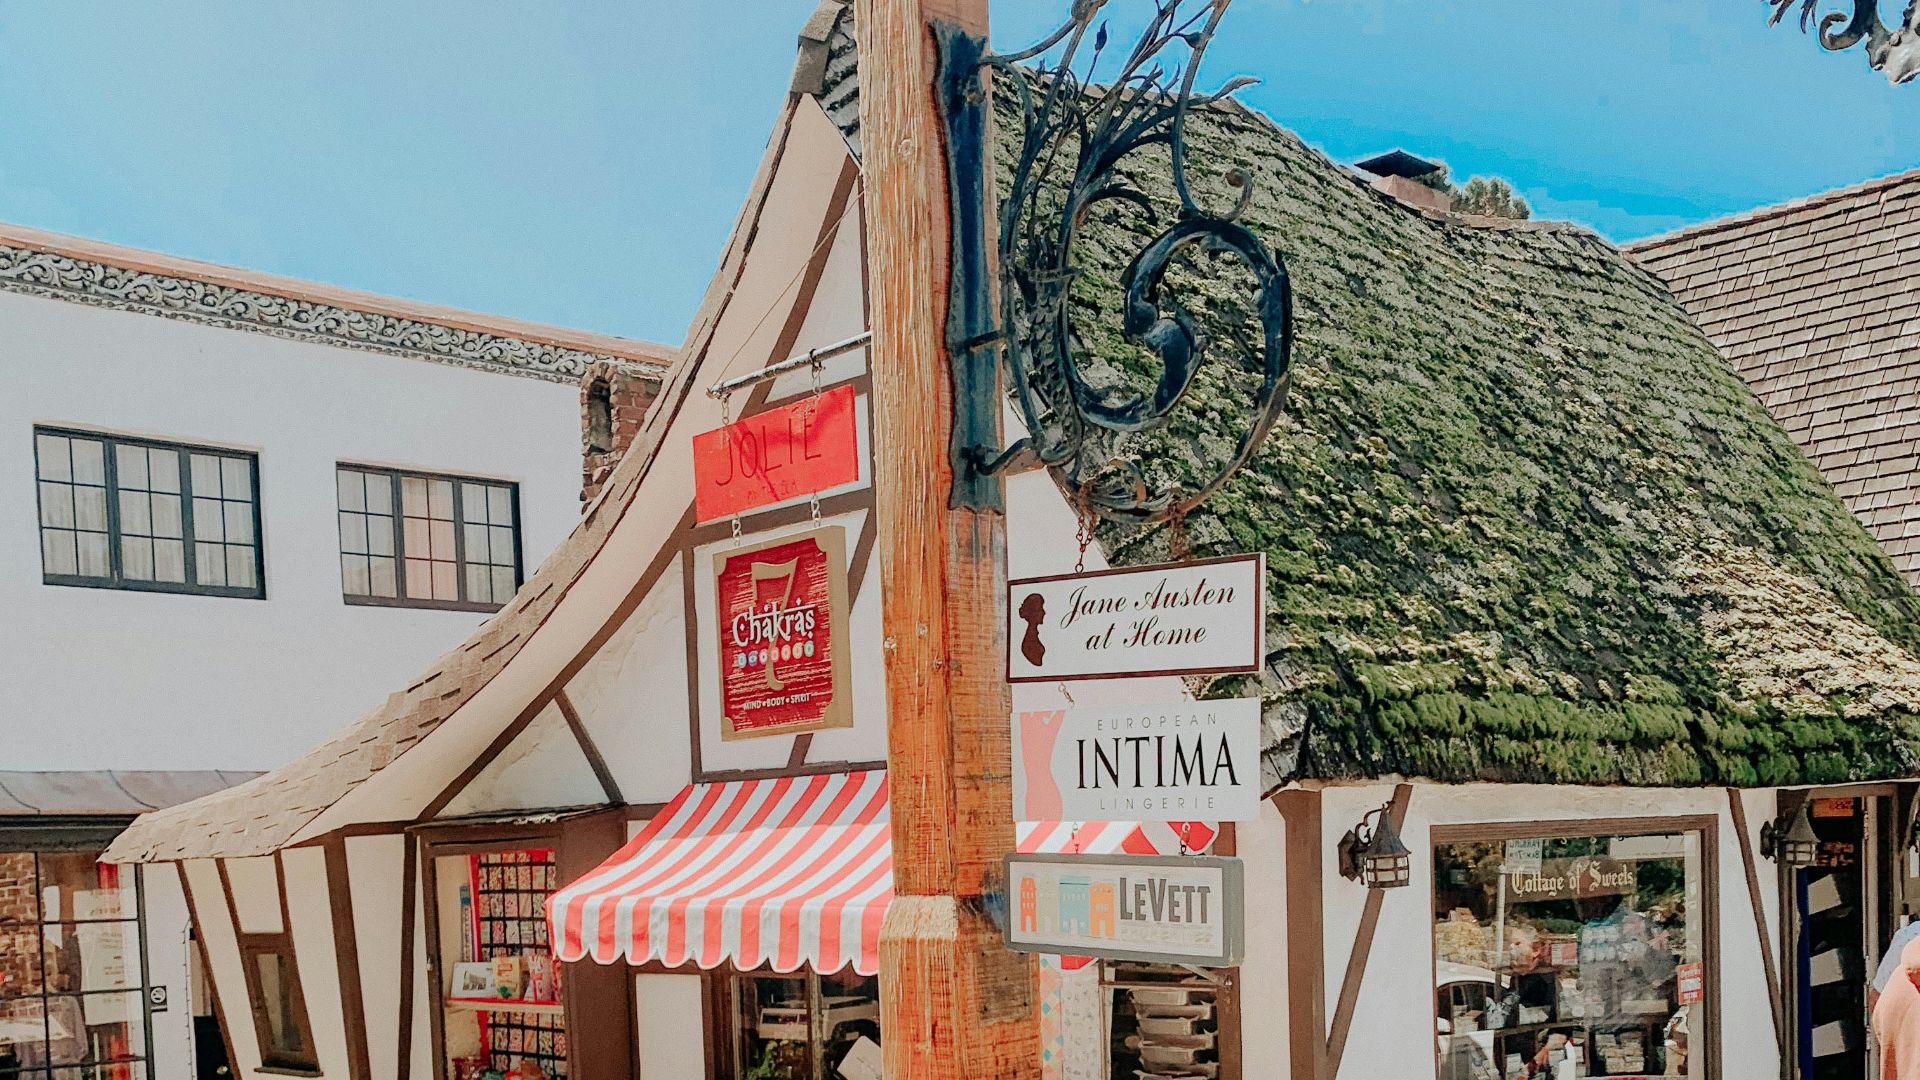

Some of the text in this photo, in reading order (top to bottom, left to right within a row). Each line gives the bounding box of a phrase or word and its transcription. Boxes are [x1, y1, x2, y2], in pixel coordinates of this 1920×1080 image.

[716, 408, 821, 486] JOLIE
[732, 597, 817, 648] Chakras
[750, 556, 800, 691] 7
[1060, 577, 1236, 630] Jane Austen
[1086, 614, 1208, 650] at Home
[743, 692, 812, 711] MIND BODY SPIRIT
[1097, 713, 1217, 731] EUROPEAN
[1076, 731, 1242, 789] INTIMA
[1100, 797, 1215, 810] LINGERIE
[1511, 859, 1634, 898] Cottage of Sweets
